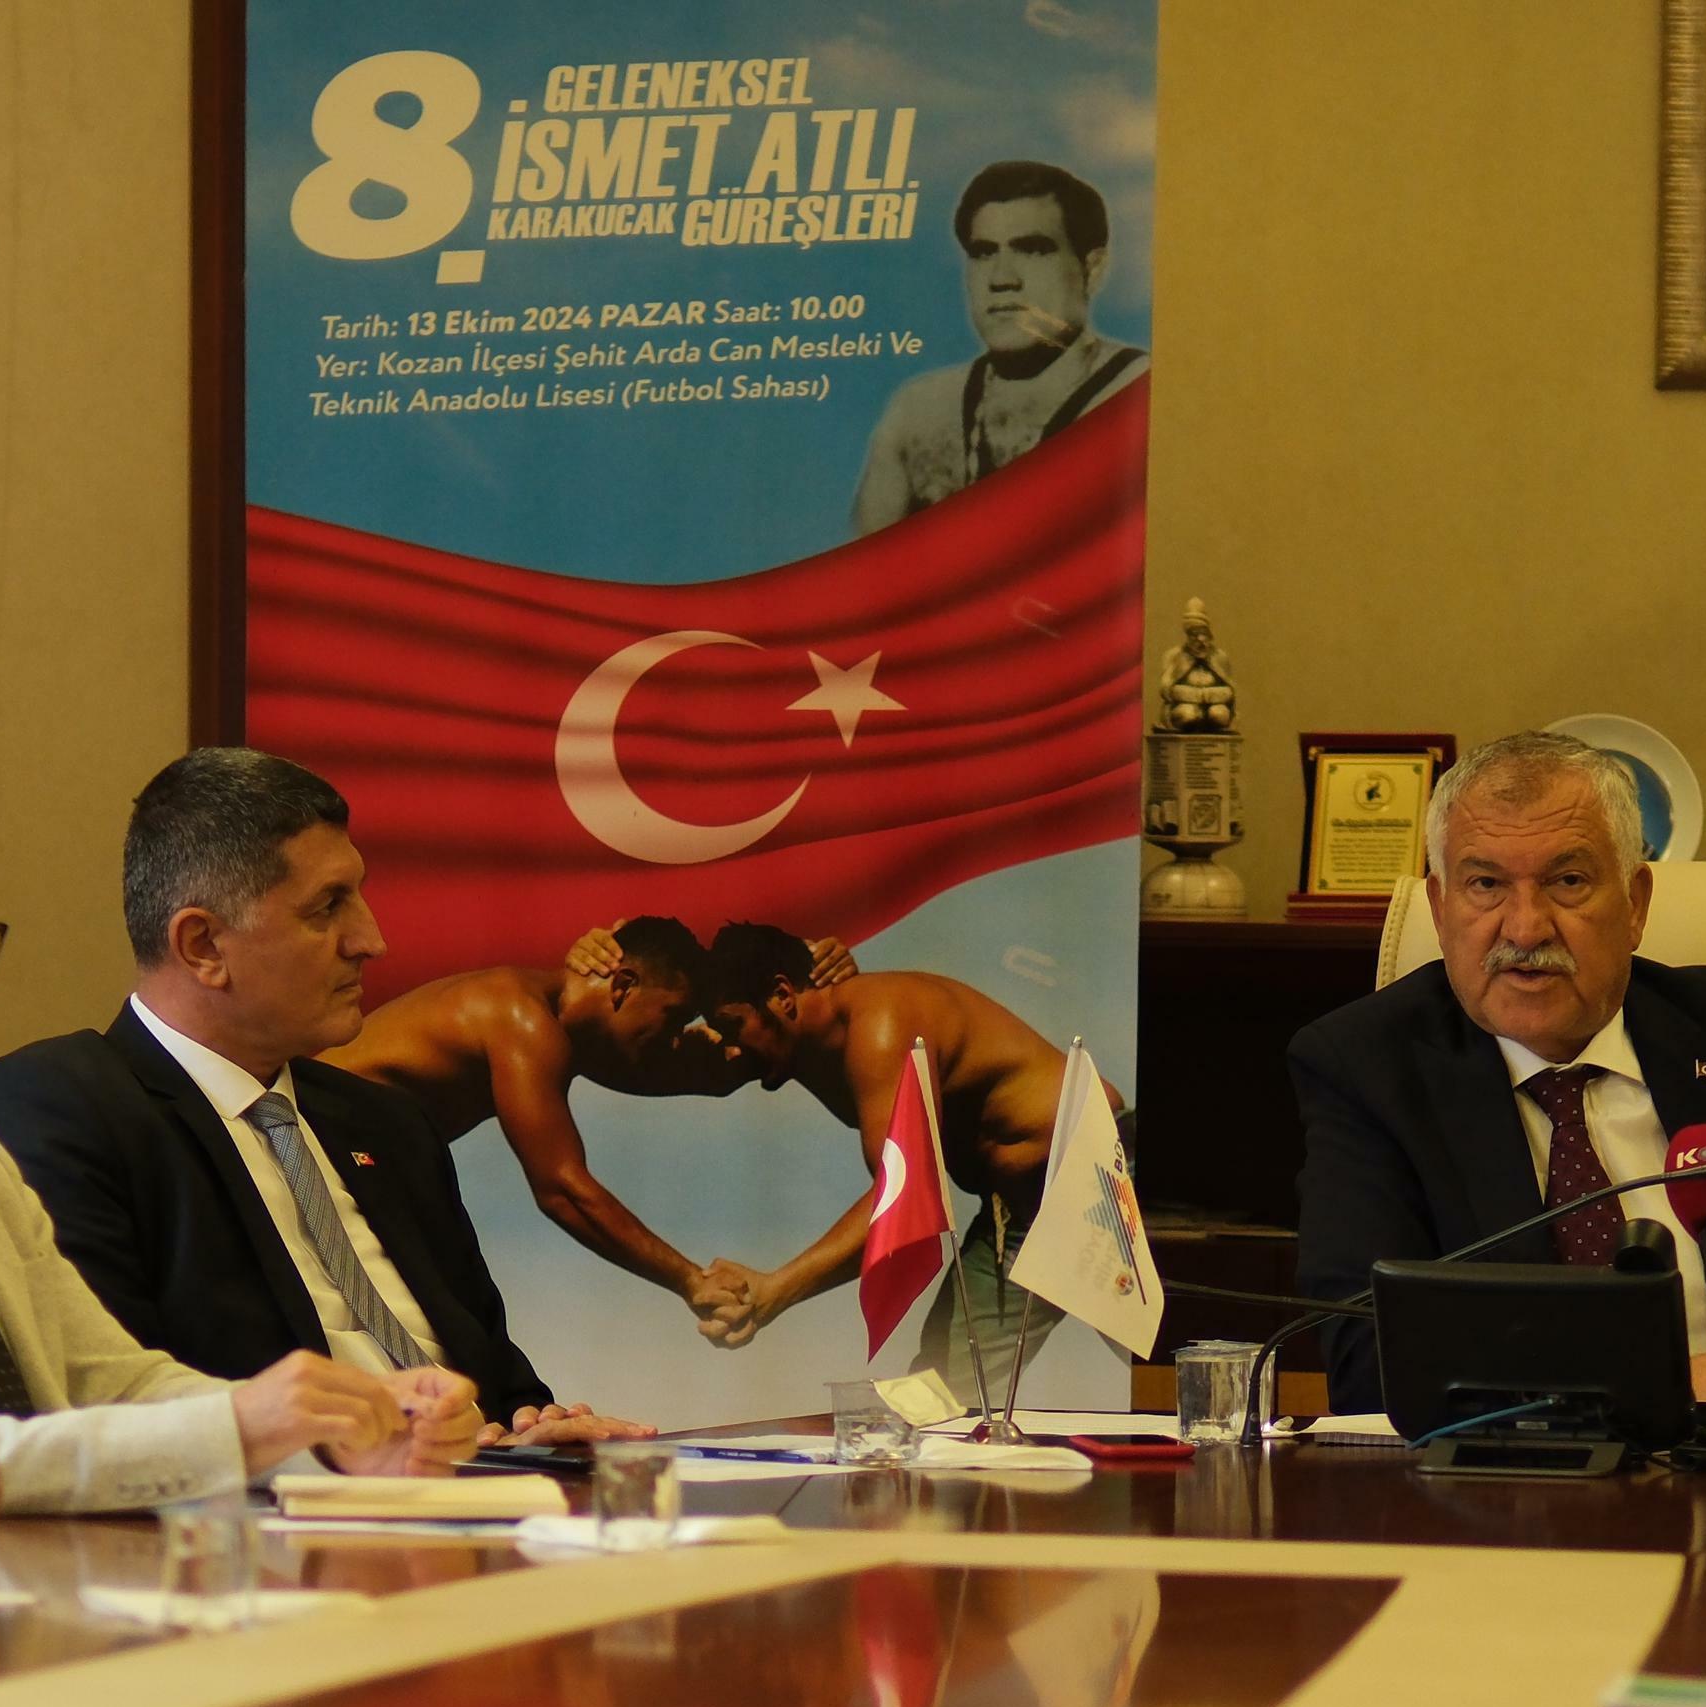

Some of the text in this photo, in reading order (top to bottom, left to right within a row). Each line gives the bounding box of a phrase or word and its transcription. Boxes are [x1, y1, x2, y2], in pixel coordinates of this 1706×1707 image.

[544, 57, 813, 113] GELENEKSEL
[290, 50, 486, 284] 8.
[493, 99, 917, 204] İSMET ATLI
[487, 180, 920, 250] KARAKUCAK GÜREŞLERİ
[321, 294, 866, 340] Tarih: 13 Ekim 2024 PAZAR Saat: 10.00
[316, 330, 923, 379] Yer: Kozan İlçesi Şehit Arda Can Mesleki Ve
[309, 374, 831, 417] Teknik Anadolu Lisesi (Futbol Sahası)
